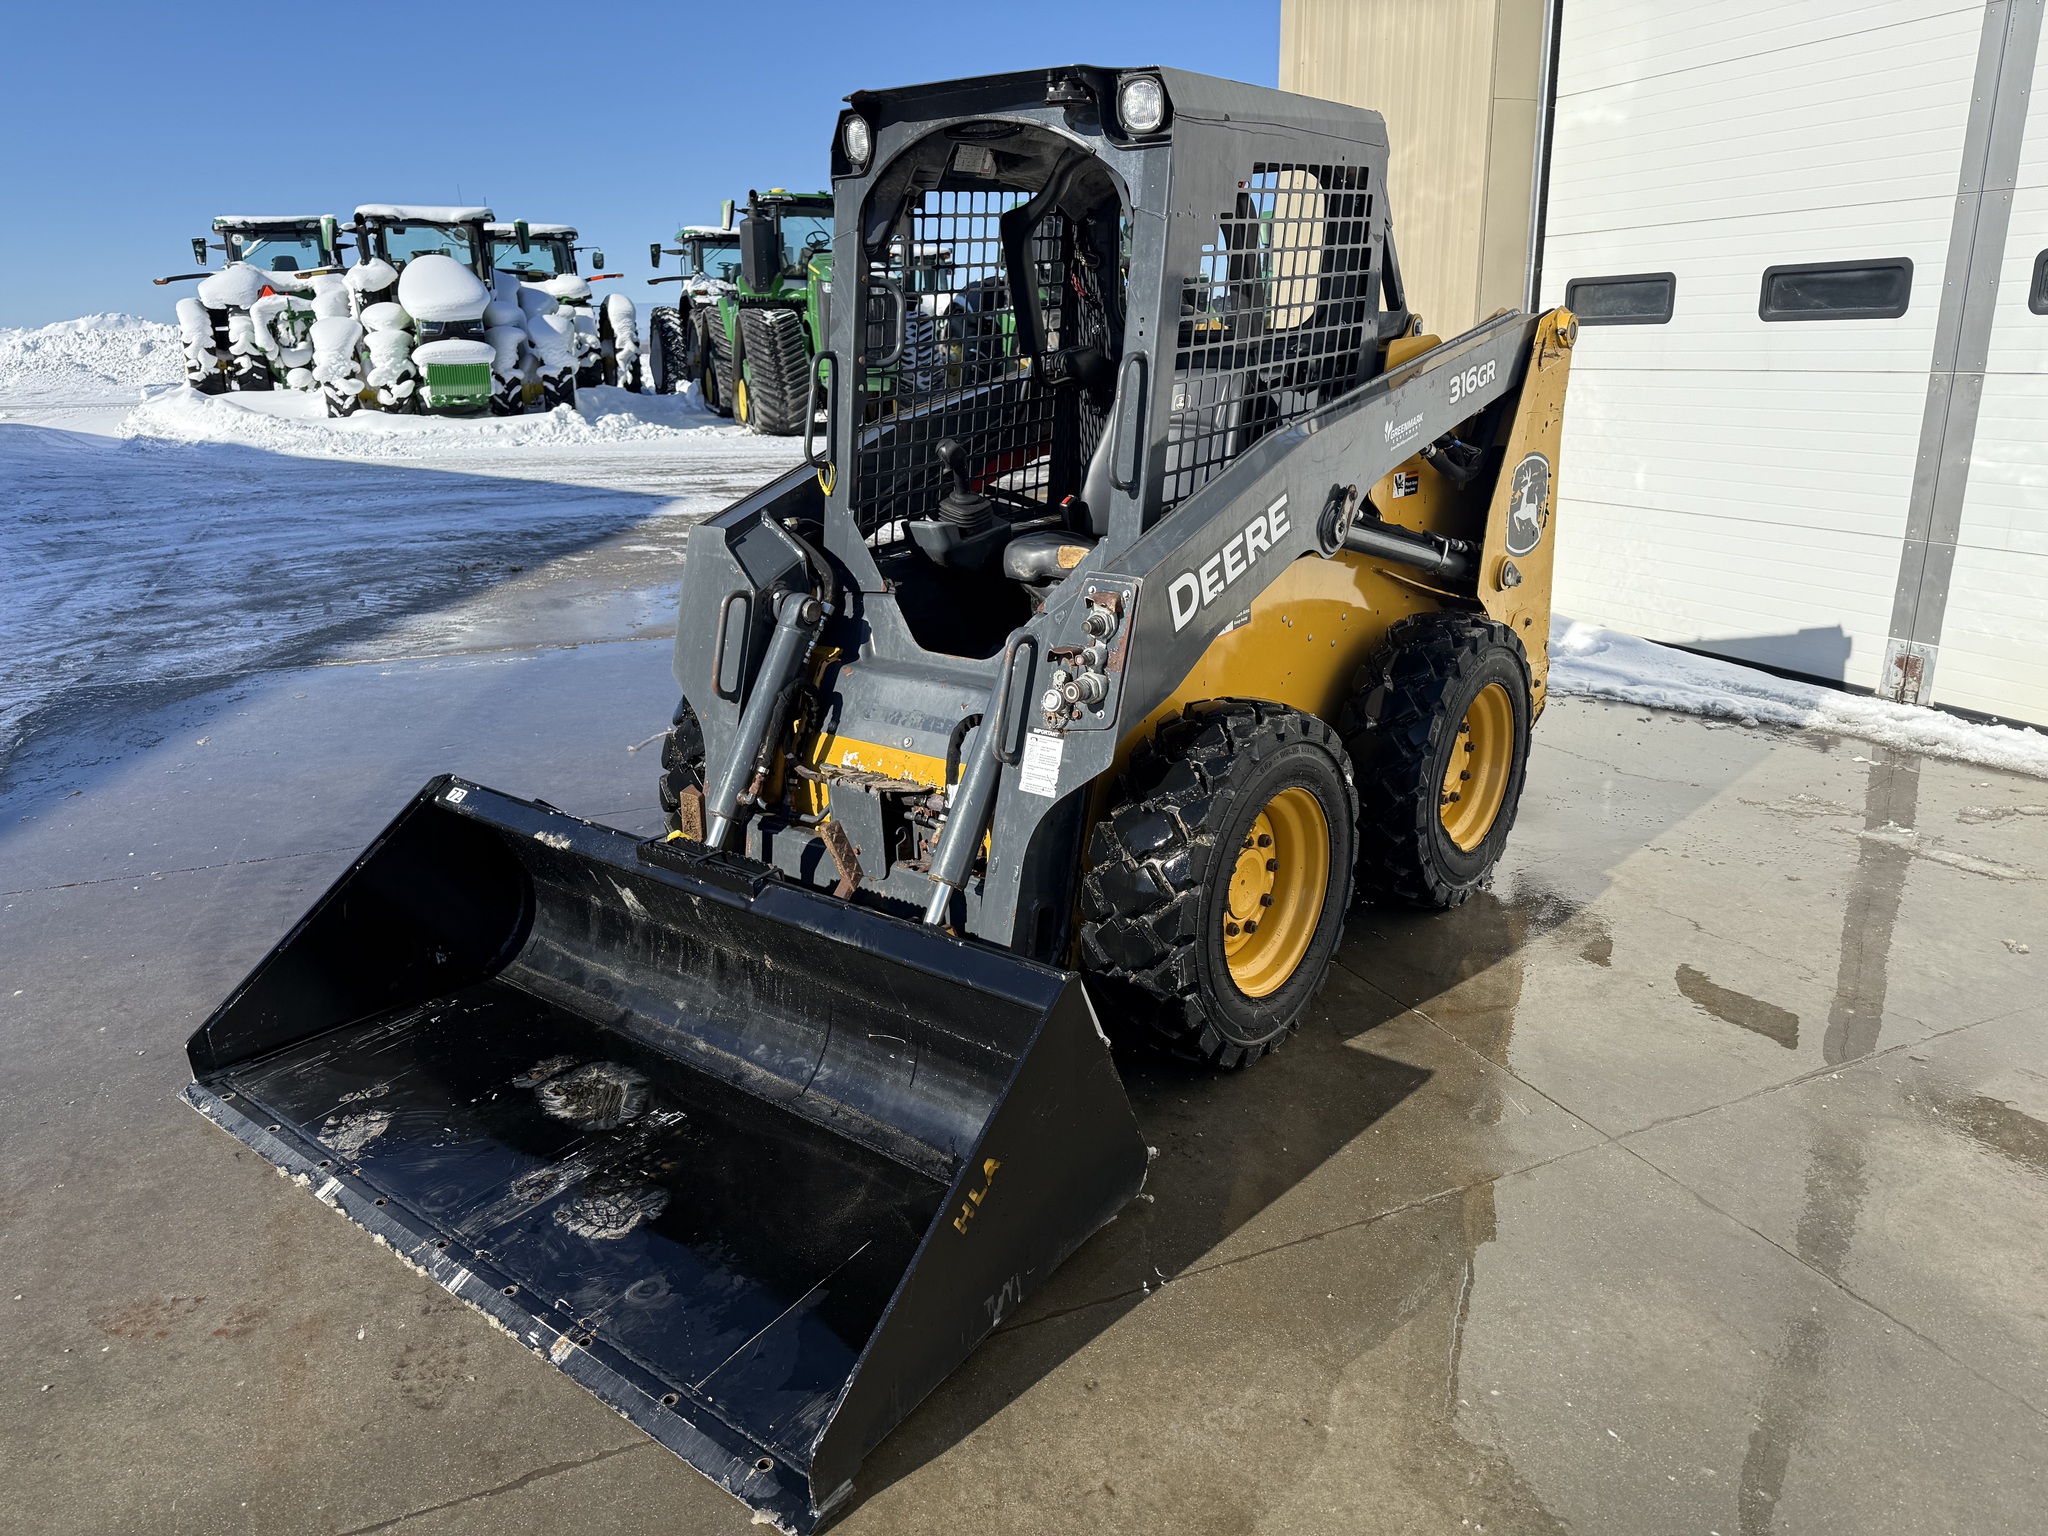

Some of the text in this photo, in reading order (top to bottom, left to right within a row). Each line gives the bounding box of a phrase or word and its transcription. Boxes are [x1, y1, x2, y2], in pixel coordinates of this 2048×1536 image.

[1449, 359, 1496, 404] 316GR
[1390, 412, 1424, 440] GREENMARK
[1168, 493, 1291, 633] DEERE
[1033, 727, 1060, 738] IMPORTANT
[449, 789, 464, 801] 72
[953, 1158, 1001, 1234] HLA
